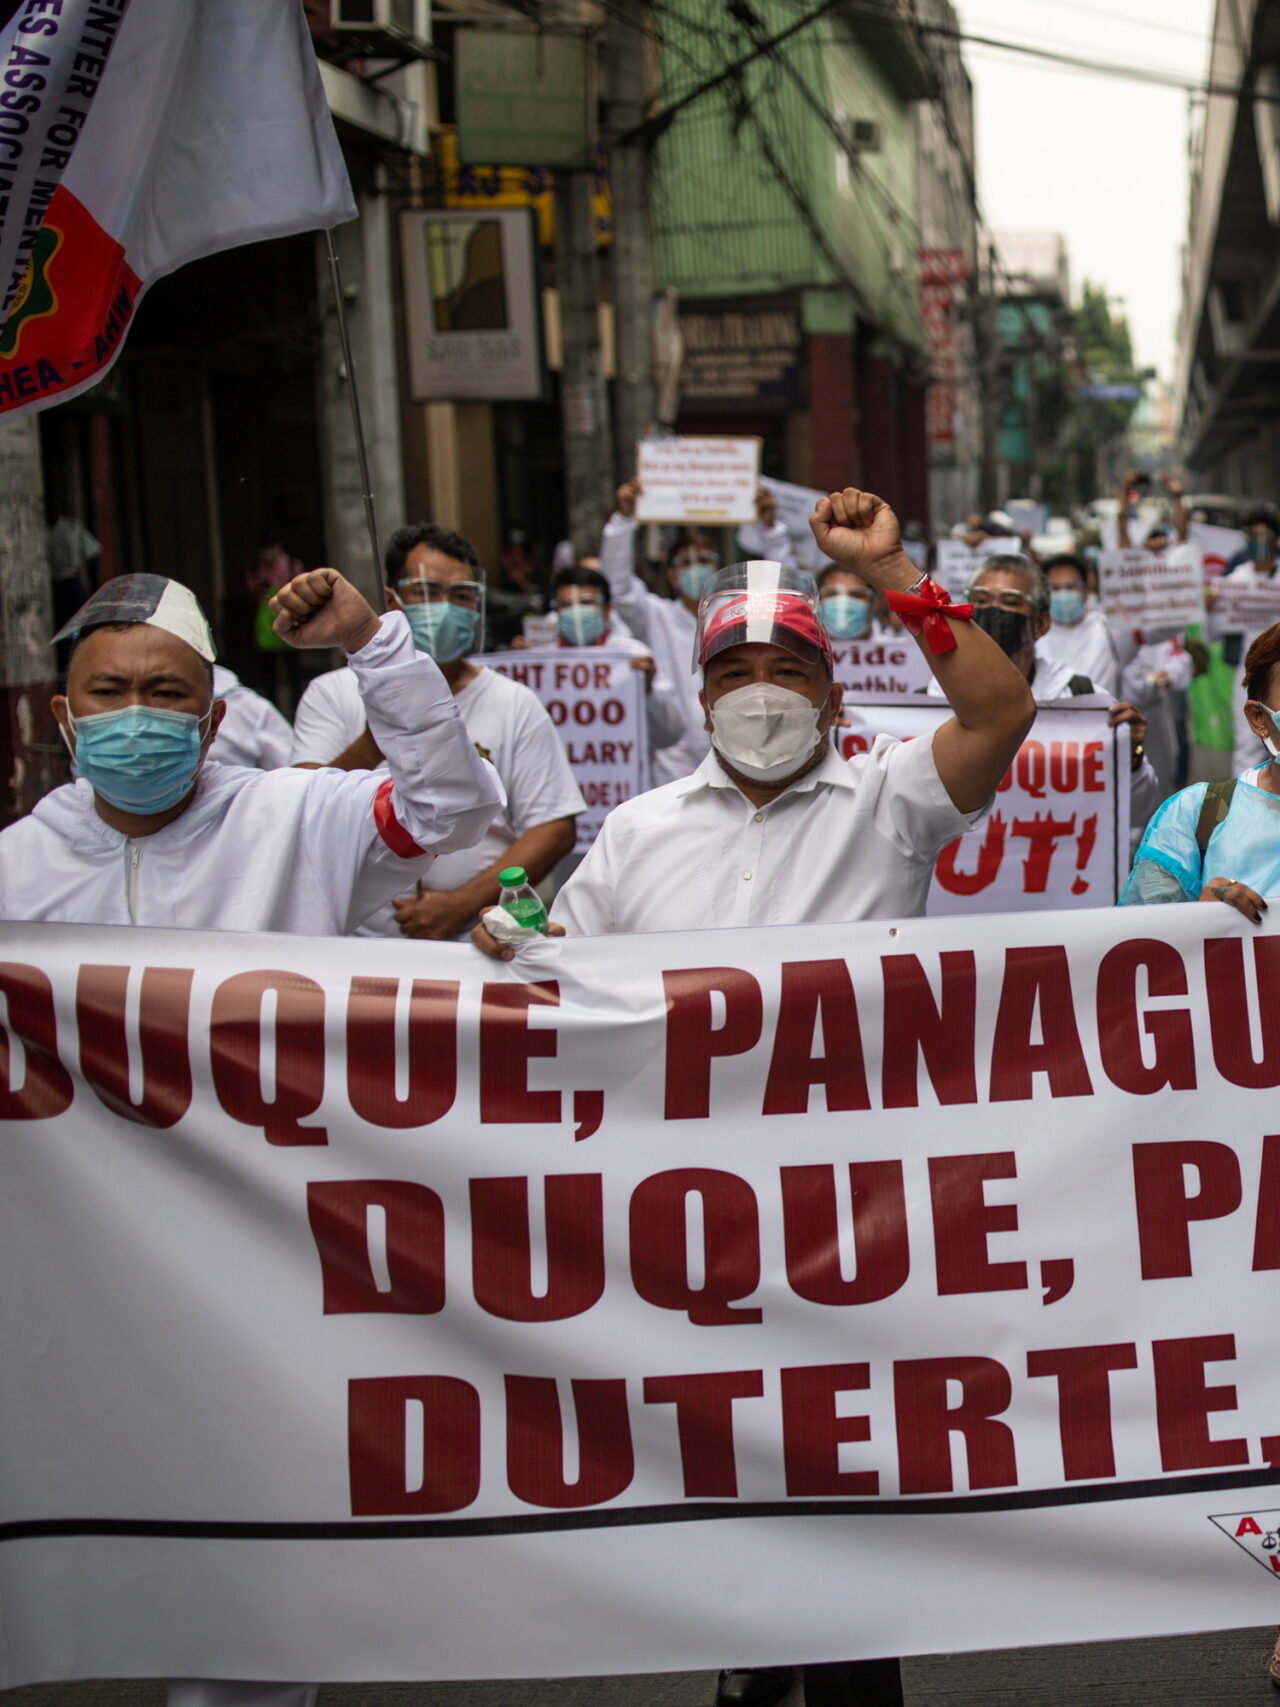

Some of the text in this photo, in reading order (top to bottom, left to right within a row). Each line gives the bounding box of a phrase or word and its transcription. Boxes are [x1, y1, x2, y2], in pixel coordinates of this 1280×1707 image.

[40, 105, 88, 171] FOR
[554, 662, 612, 690] FOR
[0, 961, 604, 1147] DUQUE,
[305, 1151, 1075, 1327] DUQUE,
